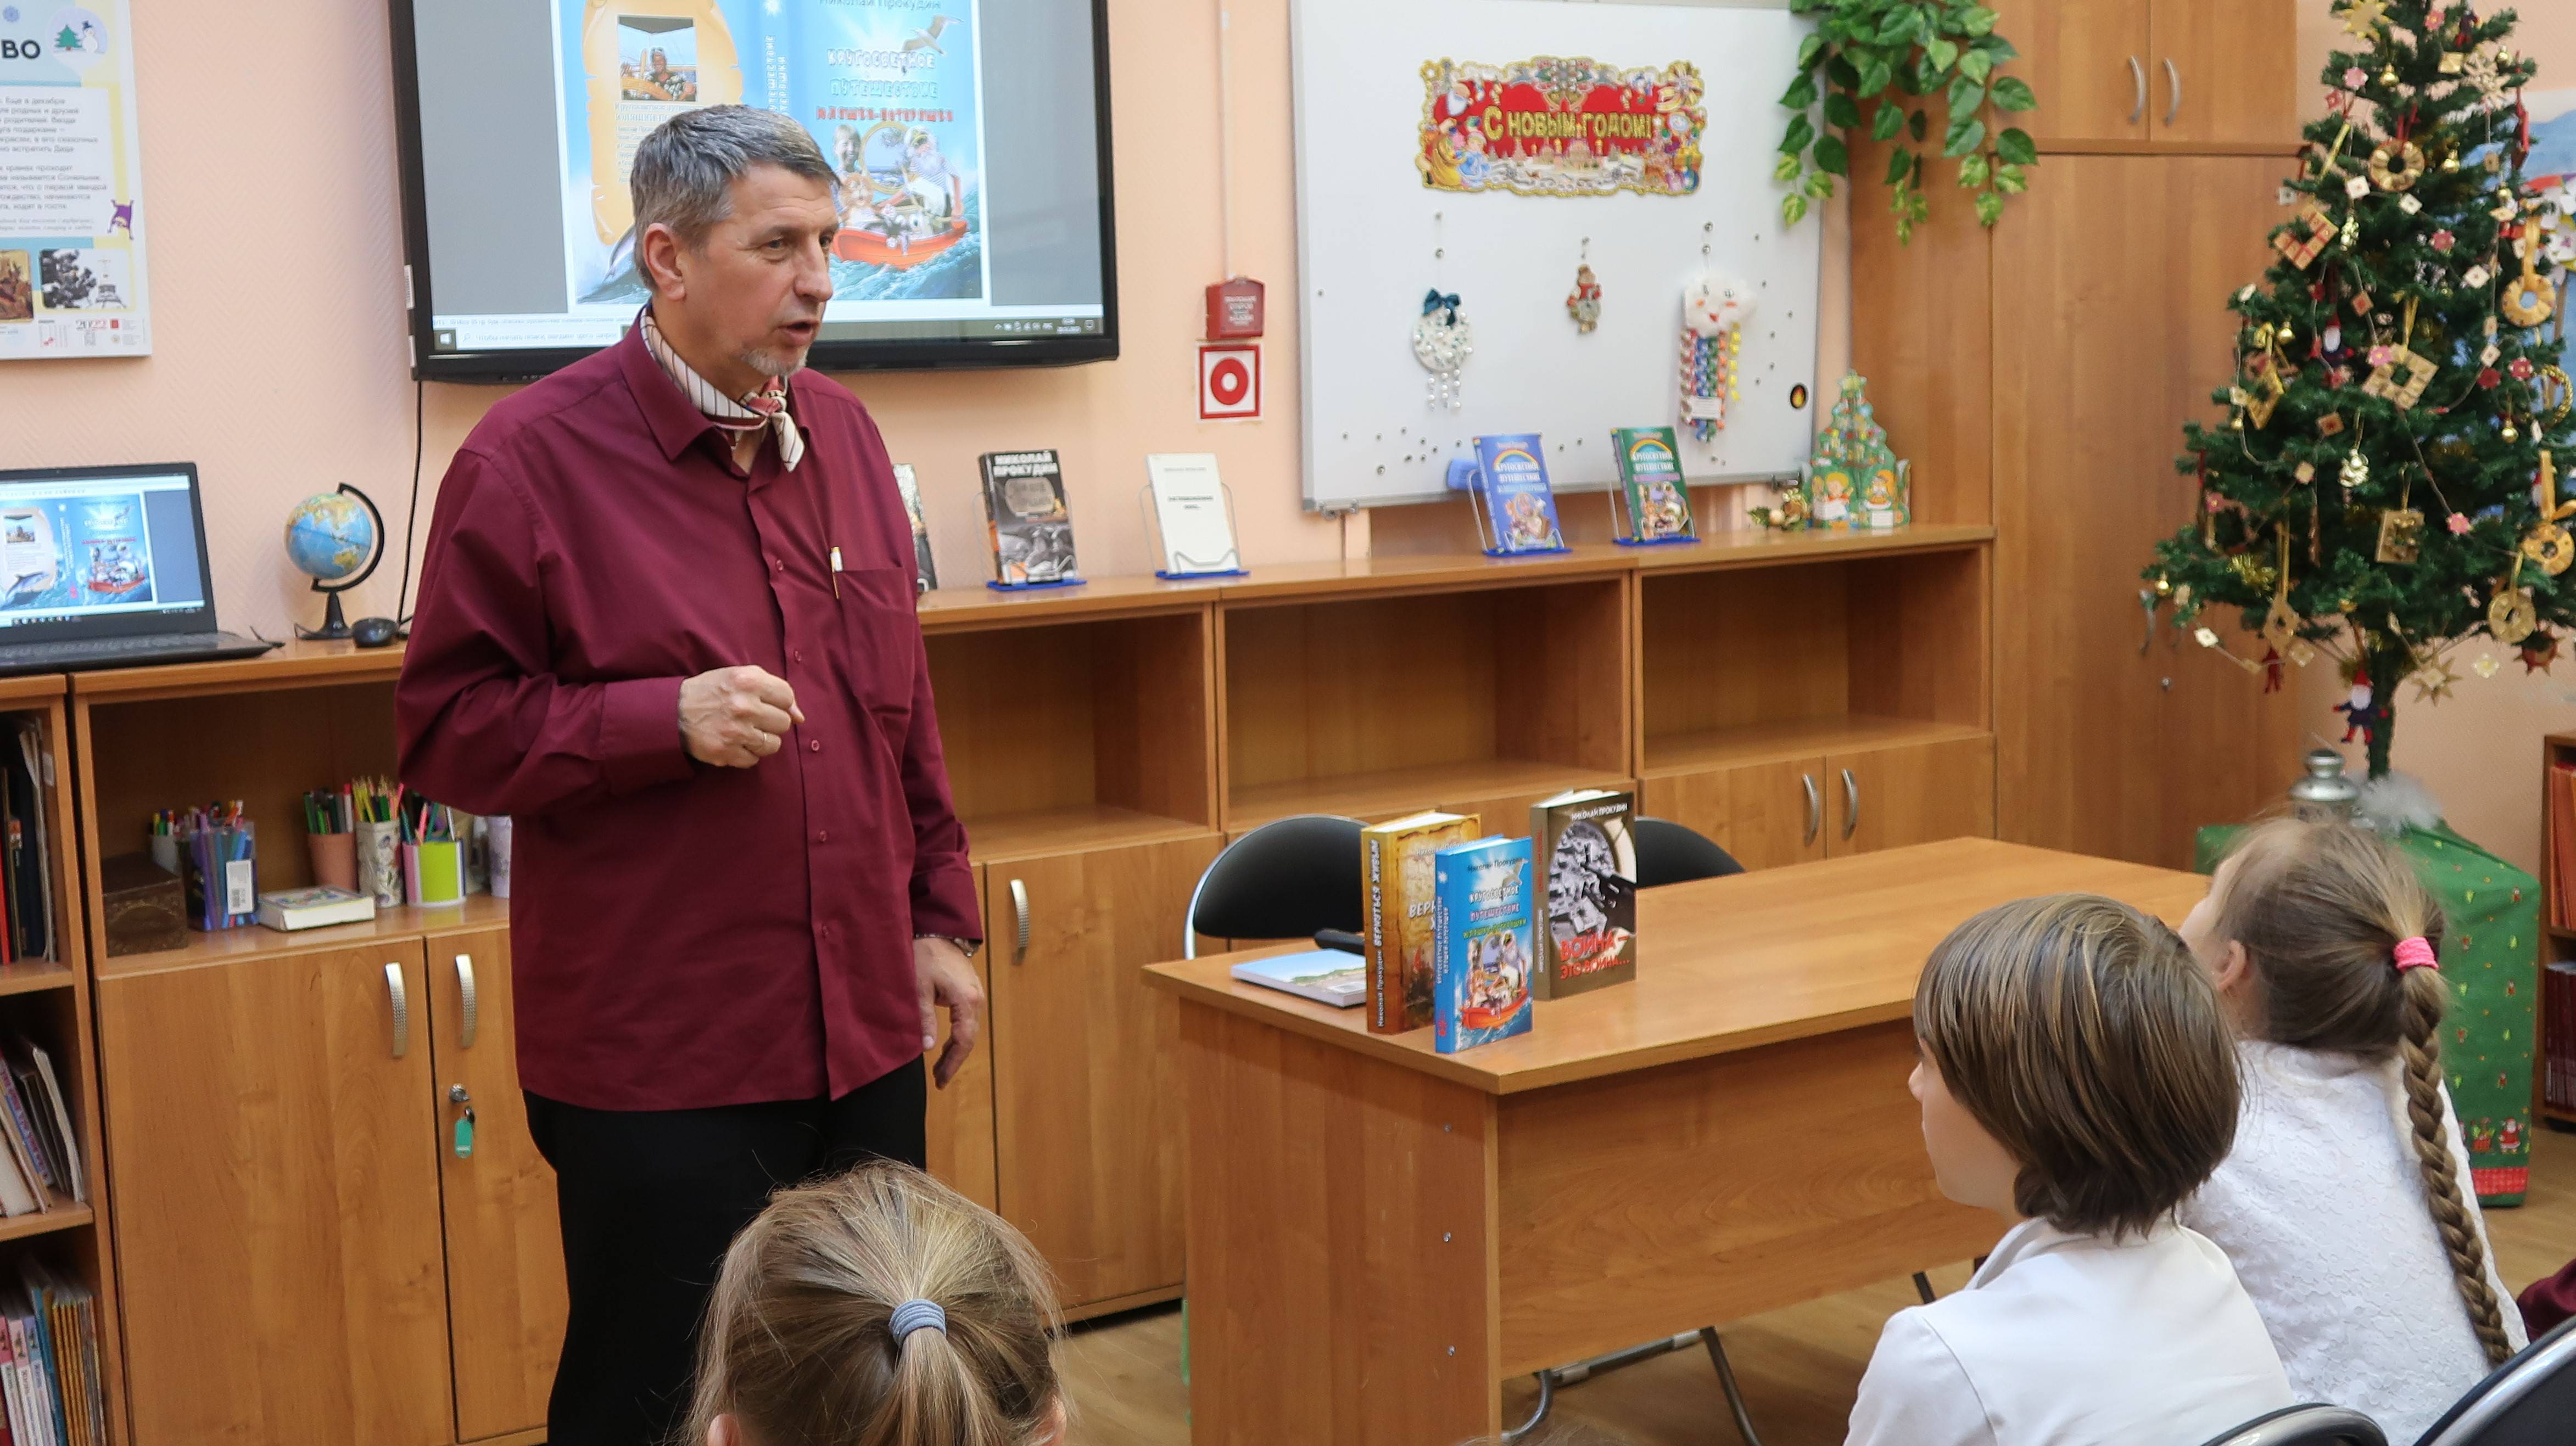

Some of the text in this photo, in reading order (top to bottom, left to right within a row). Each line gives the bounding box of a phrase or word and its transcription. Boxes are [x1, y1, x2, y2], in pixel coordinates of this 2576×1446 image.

[827, 48, 936, 69] КРУГОСВЕТНОЕ
[830, 79, 939, 99] ПУТЕШЕСТВИЕ
[1482, 104, 1653, 142] С НОВЫМ ГОДОМ!
[992, 462, 1059, 477] ПРОКУДИН
[1599, 802, 1628, 816] ПРОКУДИН
[1409, 899, 1436, 920] ВЕРН
[1560, 929, 1614, 962] ВОЙНА
[1560, 962, 1583, 980] ЭТО
